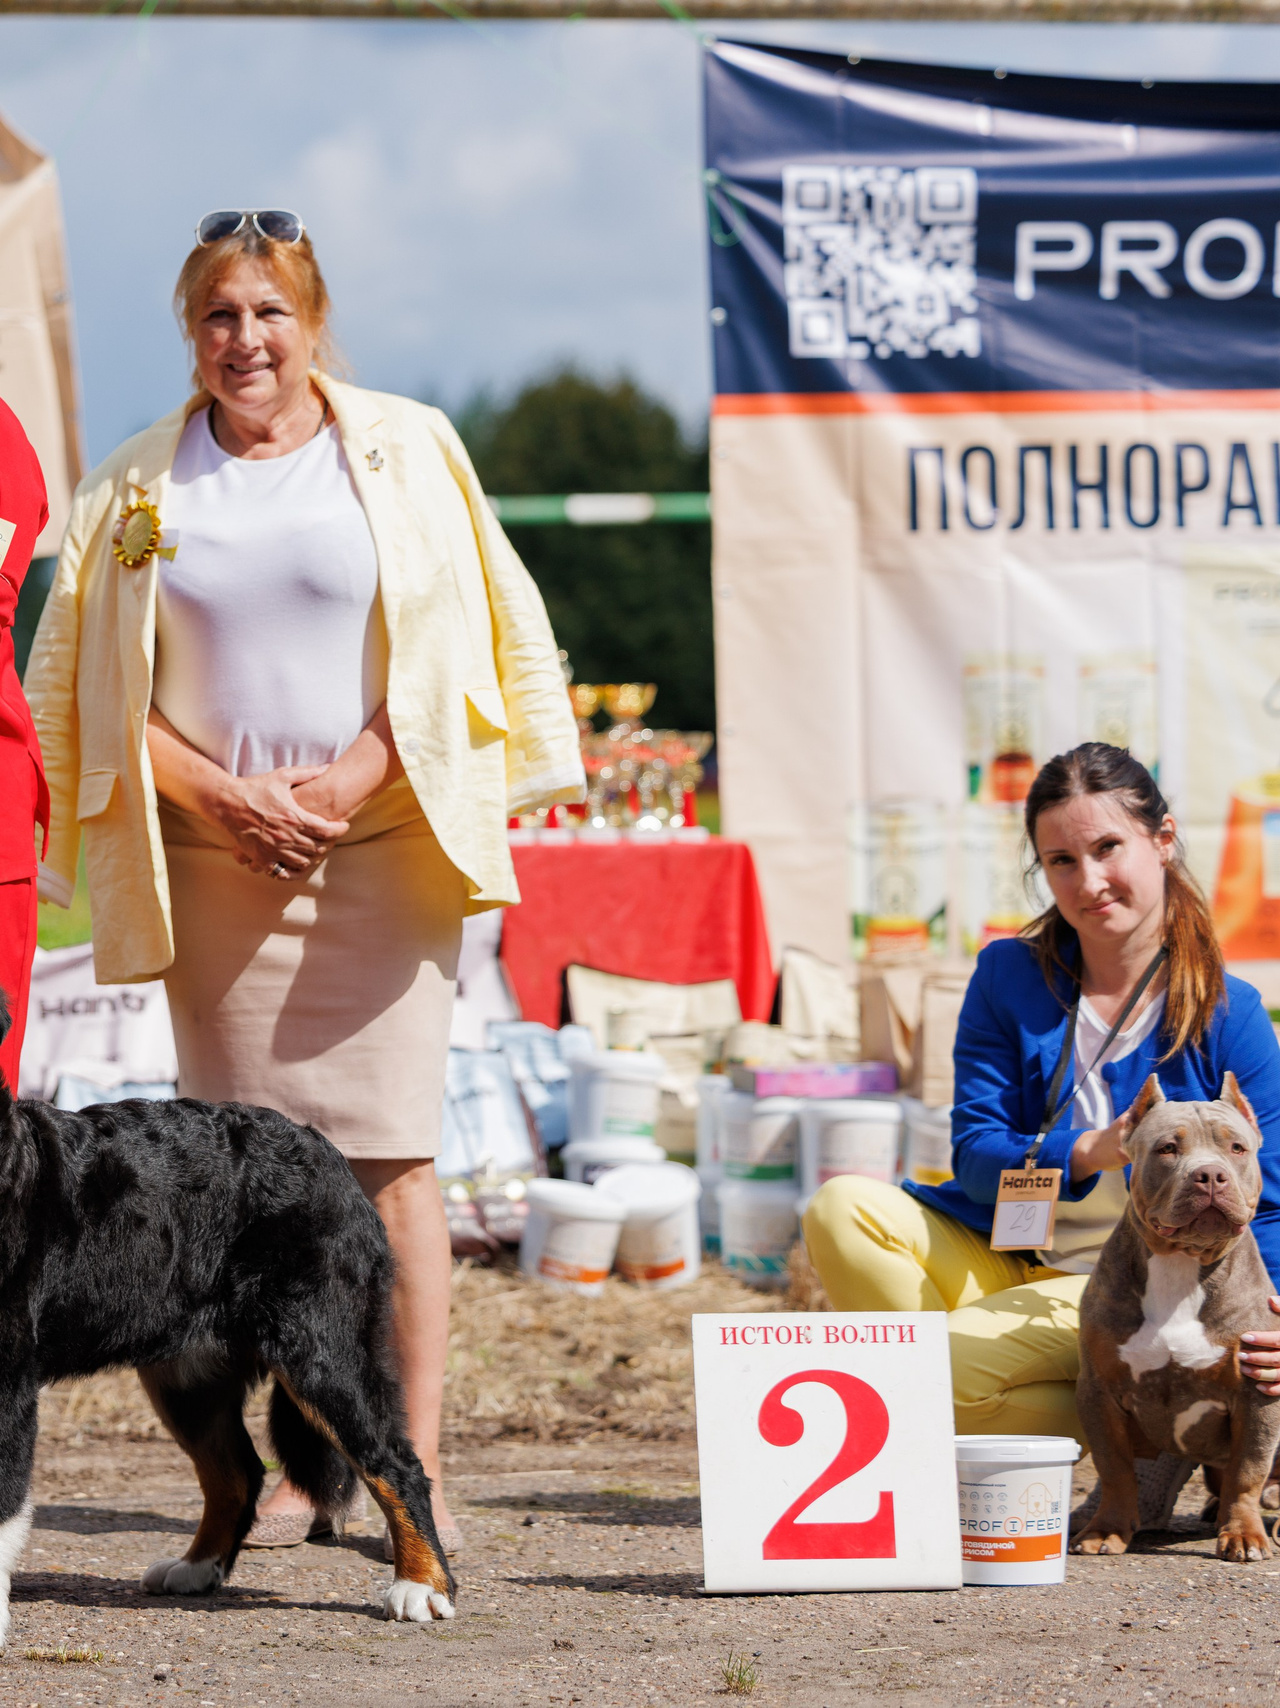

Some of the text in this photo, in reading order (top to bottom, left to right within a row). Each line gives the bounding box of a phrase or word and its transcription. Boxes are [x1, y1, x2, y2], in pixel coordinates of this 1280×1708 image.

[1014, 218, 1280, 300] PRO
[906, 441, 1280, 532] ПОЛНОРА
[1002, 1175, 1054, 1189] Hanta
[1009, 1204, 1037, 1232] 29
[719, 1324, 916, 1345] ИСТОК ВОЛГИ
[758, 1369, 897, 1561] 2
[964, 1541, 1016, 1550] ГОВЯДИНОЙ
[964, 1548, 995, 1556] РИСОМ
